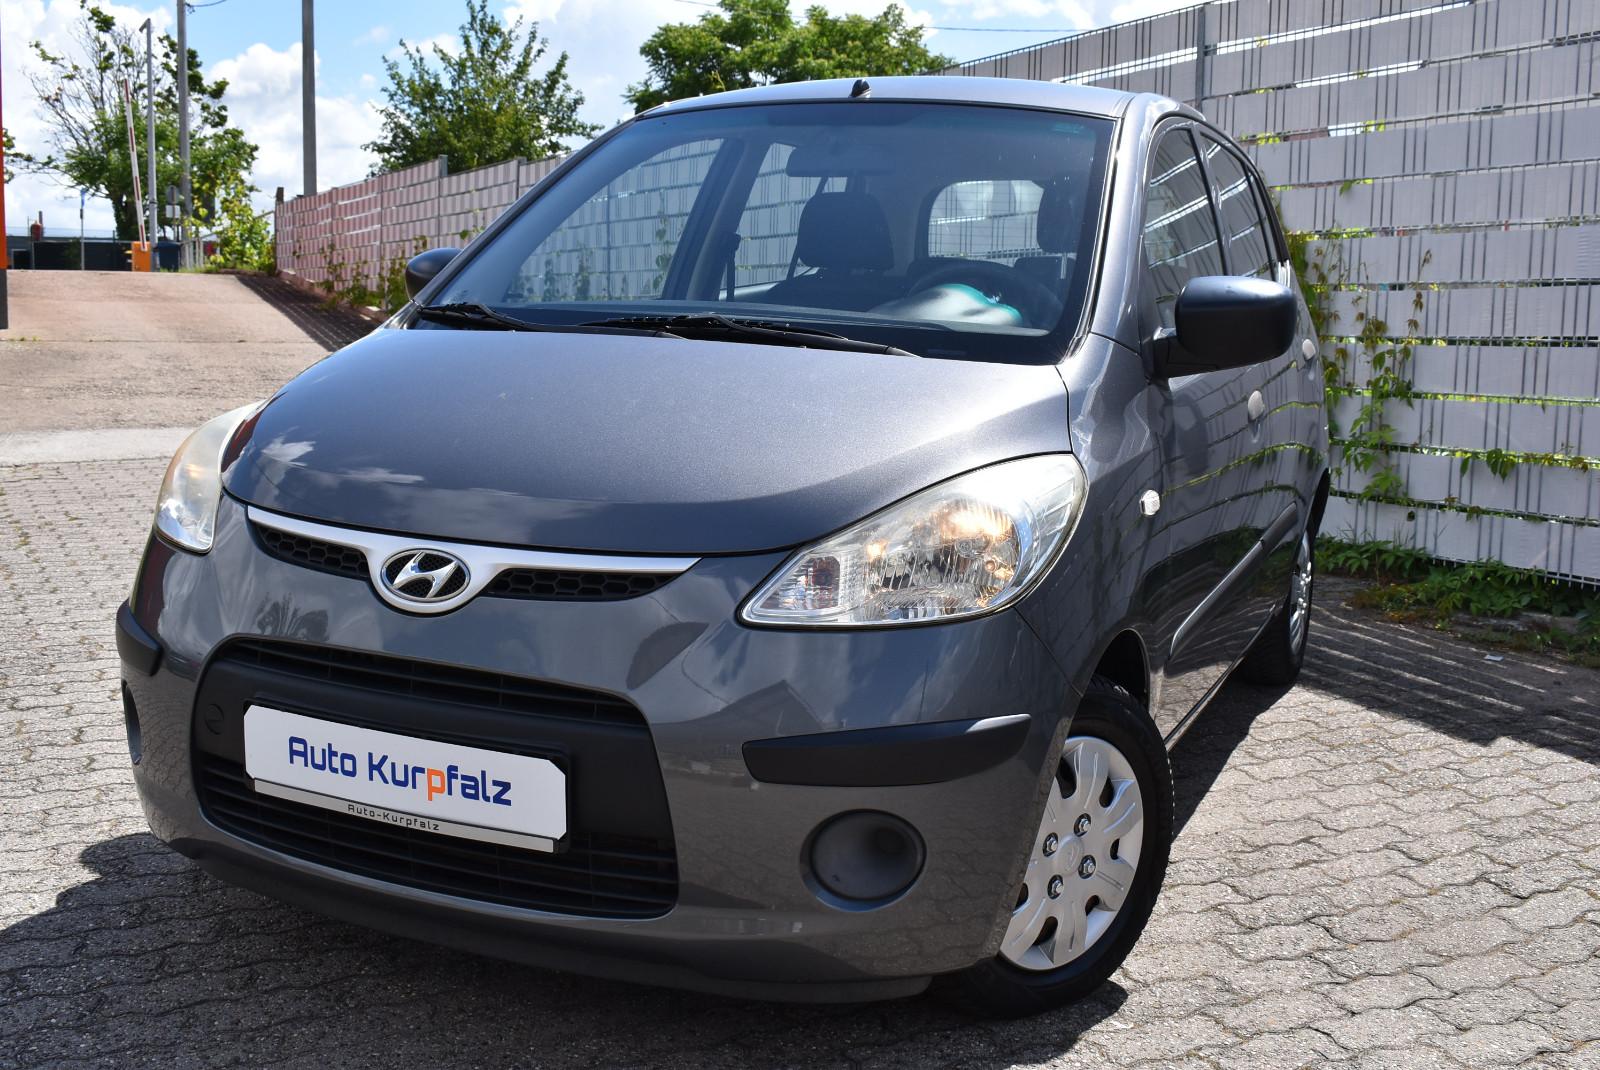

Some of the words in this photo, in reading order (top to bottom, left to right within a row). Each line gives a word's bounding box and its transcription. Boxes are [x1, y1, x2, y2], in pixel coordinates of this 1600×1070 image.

[289, 736, 357, 778] Auto
[368, 752, 511, 807] Kurpfalz
[347, 804, 440, 831] Auto-Kurpfalz
